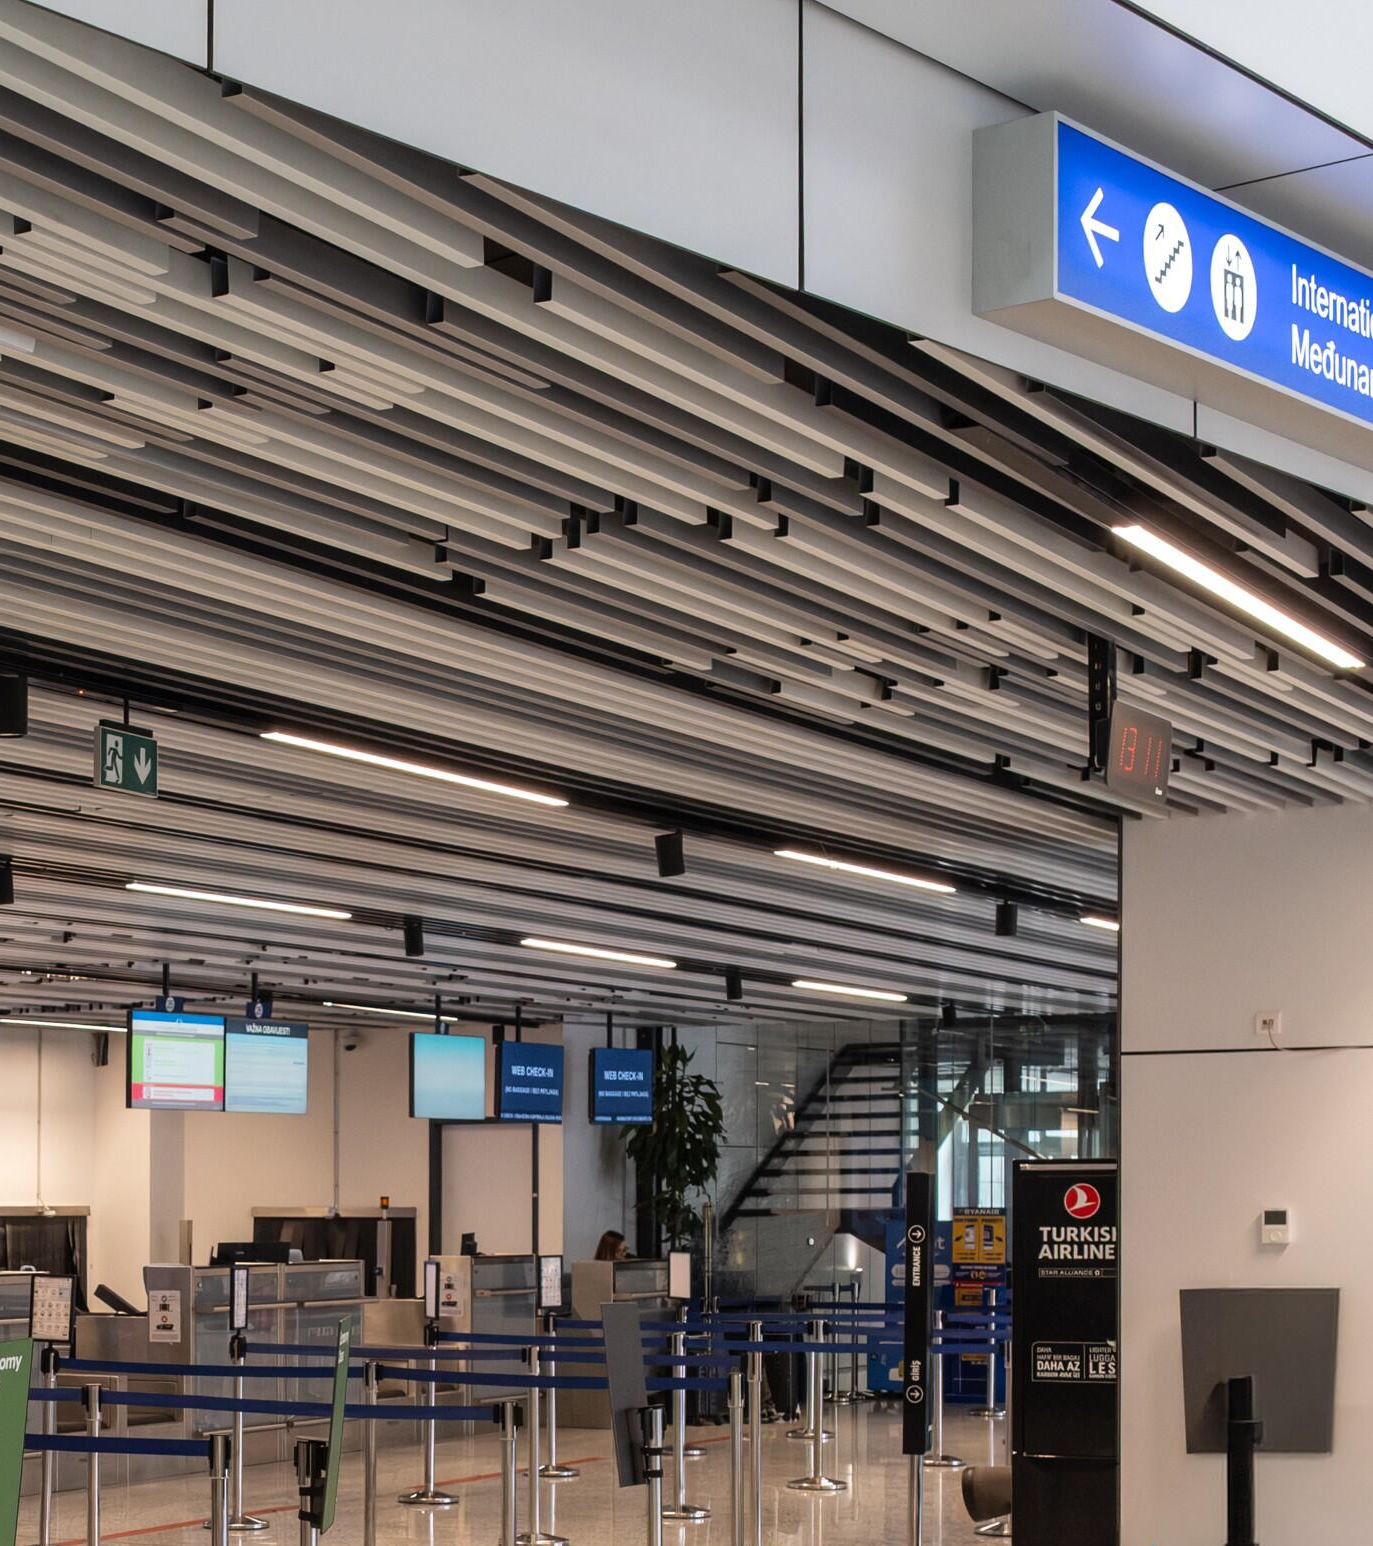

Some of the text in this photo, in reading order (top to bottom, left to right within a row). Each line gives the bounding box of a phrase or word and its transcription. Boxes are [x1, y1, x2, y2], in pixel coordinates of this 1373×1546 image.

[1291, 263, 1373, 339] Internati
[511, 1065, 554, 1078] WEB CHECK-IN
[603, 1070, 644, 1081] WEB CHECK-IN
[1038, 1244, 1115, 1260] AIRLINE
[912, 1246, 921, 1287] ENTRANCE
[1089, 1354, 1116, 1362] LUGGA
[1037, 1361, 1080, 1371] DAHA AZ
[1089, 1361, 1116, 1374] LES
